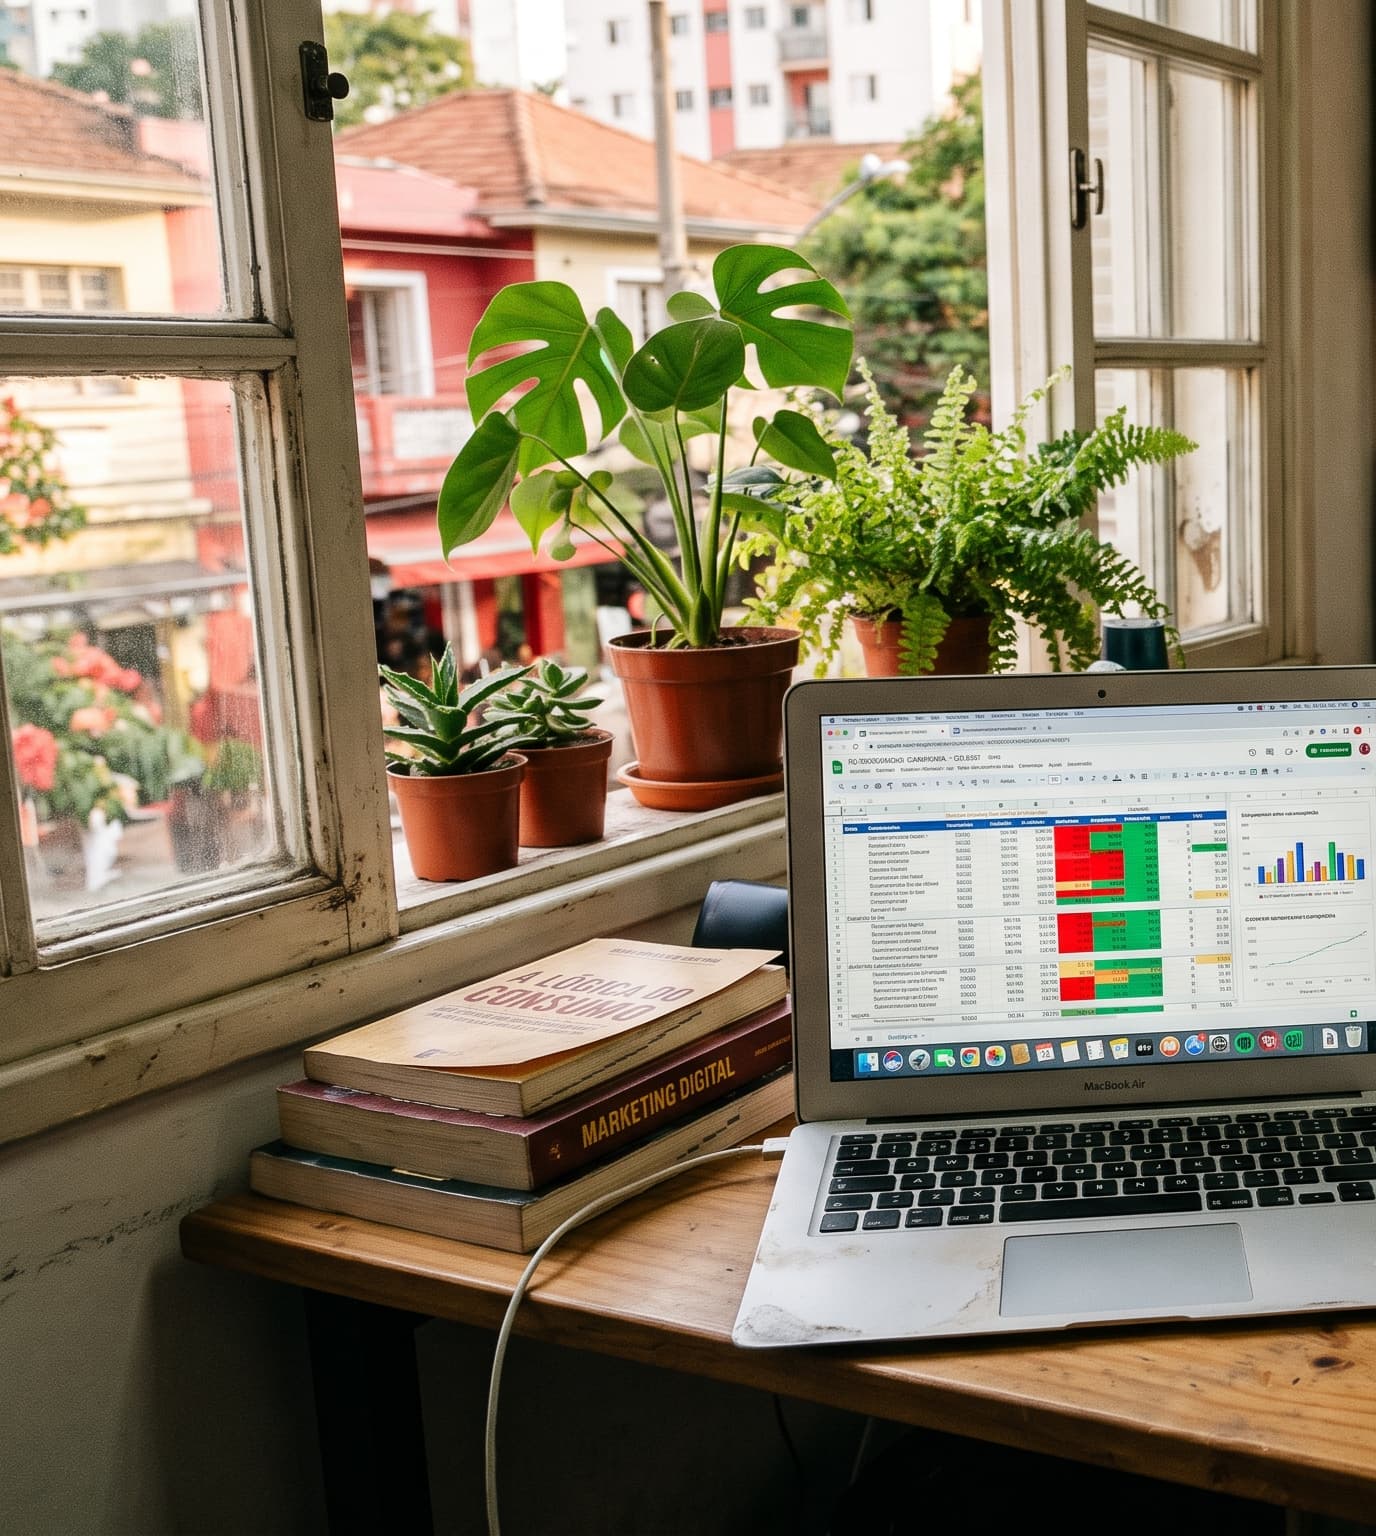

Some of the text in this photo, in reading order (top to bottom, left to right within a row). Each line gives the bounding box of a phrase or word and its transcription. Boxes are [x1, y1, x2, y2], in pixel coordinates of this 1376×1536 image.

[463, 985, 657, 1023] CONSUMO
[510, 971, 695, 1003] A LÓGICA DO
[1084, 1079, 1145, 1090] MacBook Air
[581, 1056, 736, 1149] MARKETING DIGITAL
